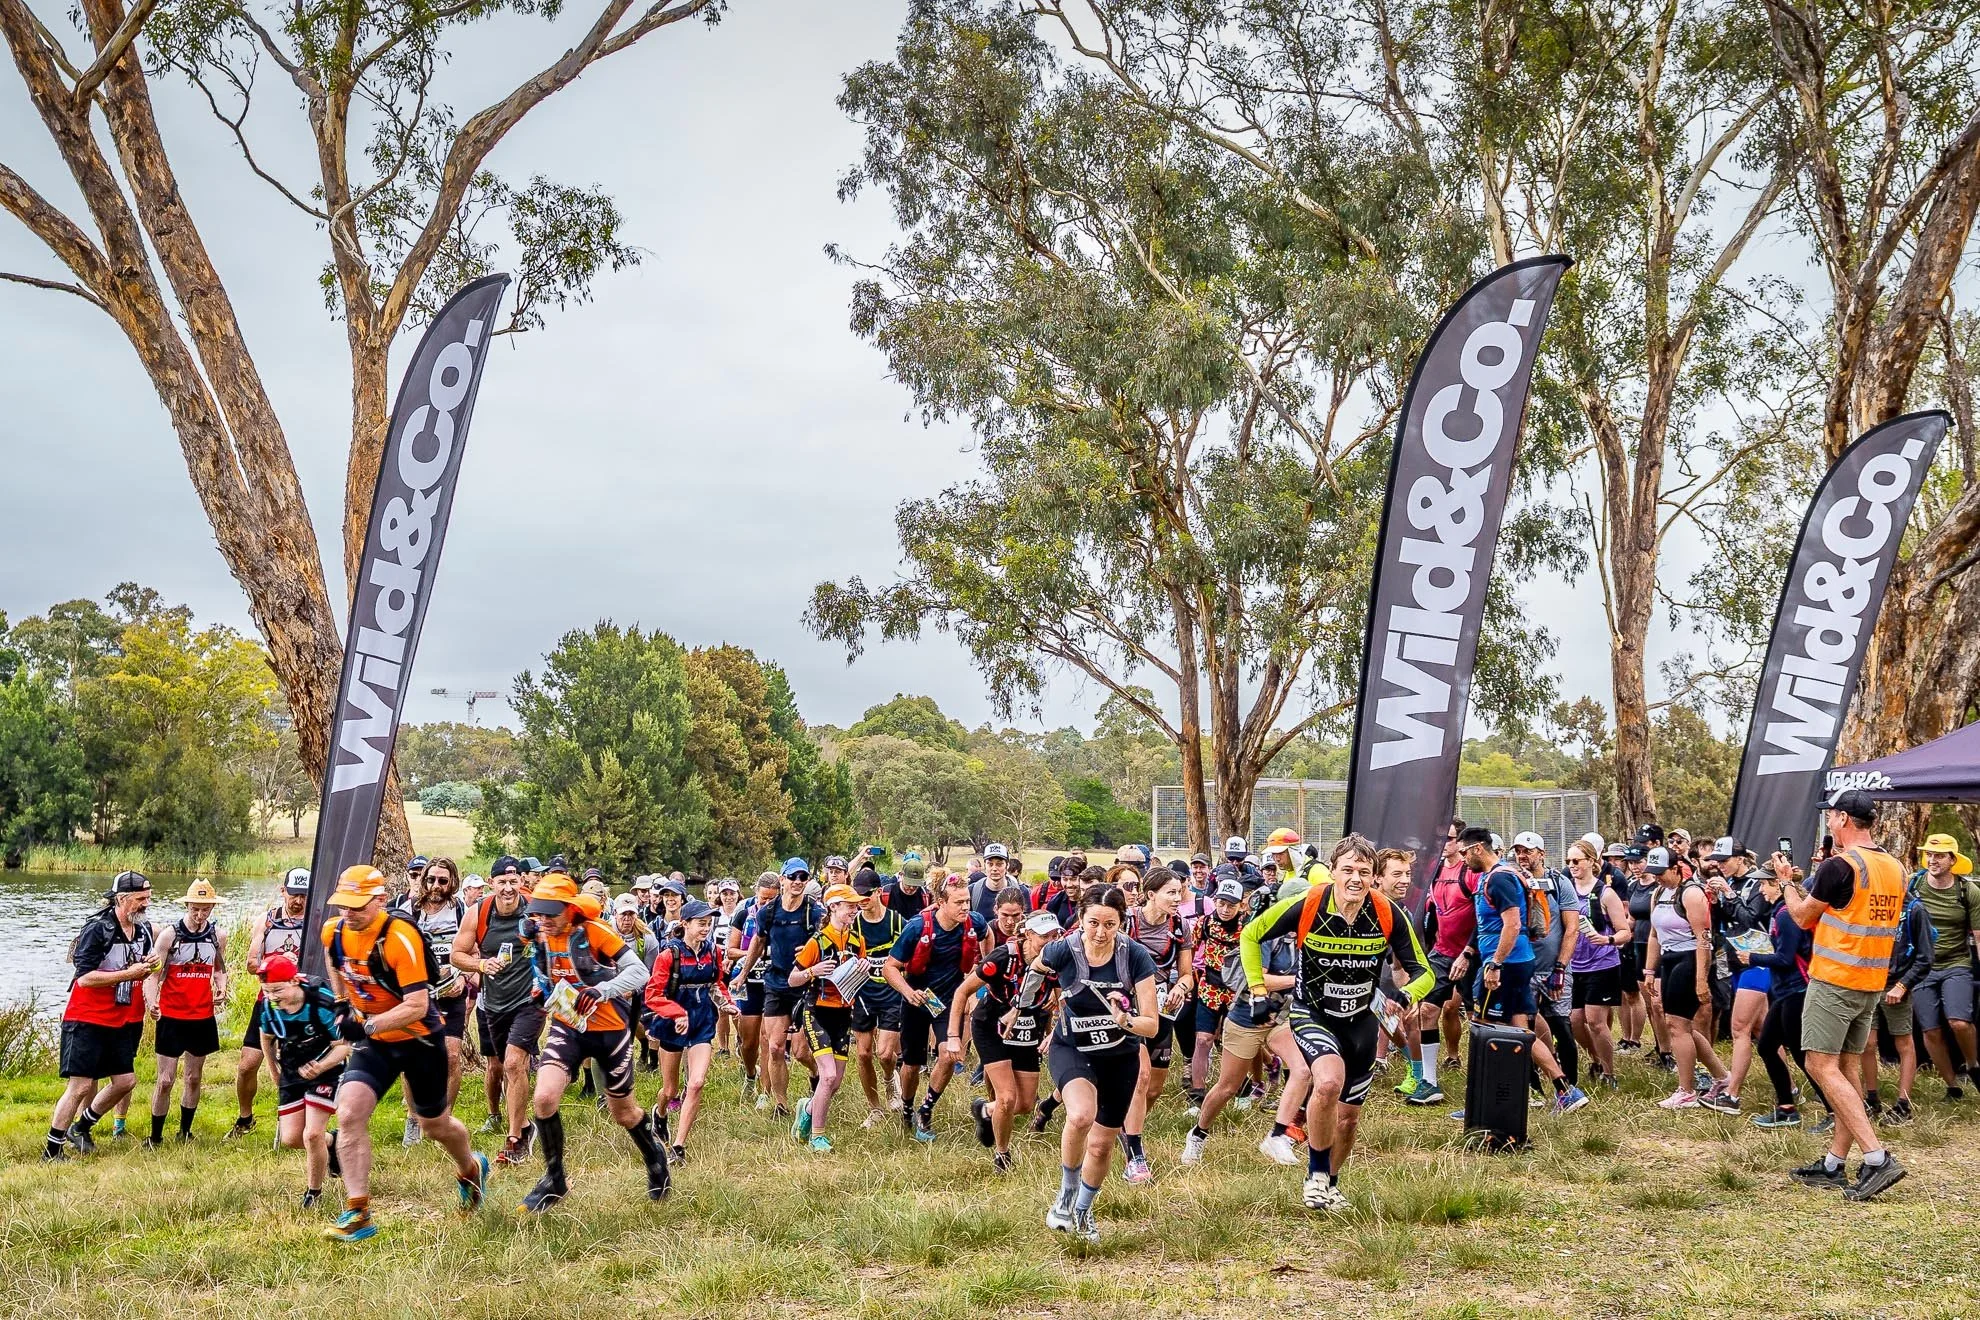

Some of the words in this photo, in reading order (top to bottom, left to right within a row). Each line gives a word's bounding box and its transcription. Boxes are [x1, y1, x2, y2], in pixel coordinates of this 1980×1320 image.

[1370, 299, 1535, 771] Wild&Co.
[332, 320, 483, 793] Wild&Co.
[1757, 438, 1926, 776] Wild&Co.
[1869, 895, 1898, 907] EVENT
[1869, 909, 1895, 921] CREW
[1306, 938, 1386, 951] cannondal
[1318, 958, 1378, 968] GARMIN
[1329, 986, 1368, 996] Wild&Co.
[1341, 999, 1356, 1012] 58
[1017, 1030, 1031, 1041] 48
[1090, 1030, 1109, 1044] 58
